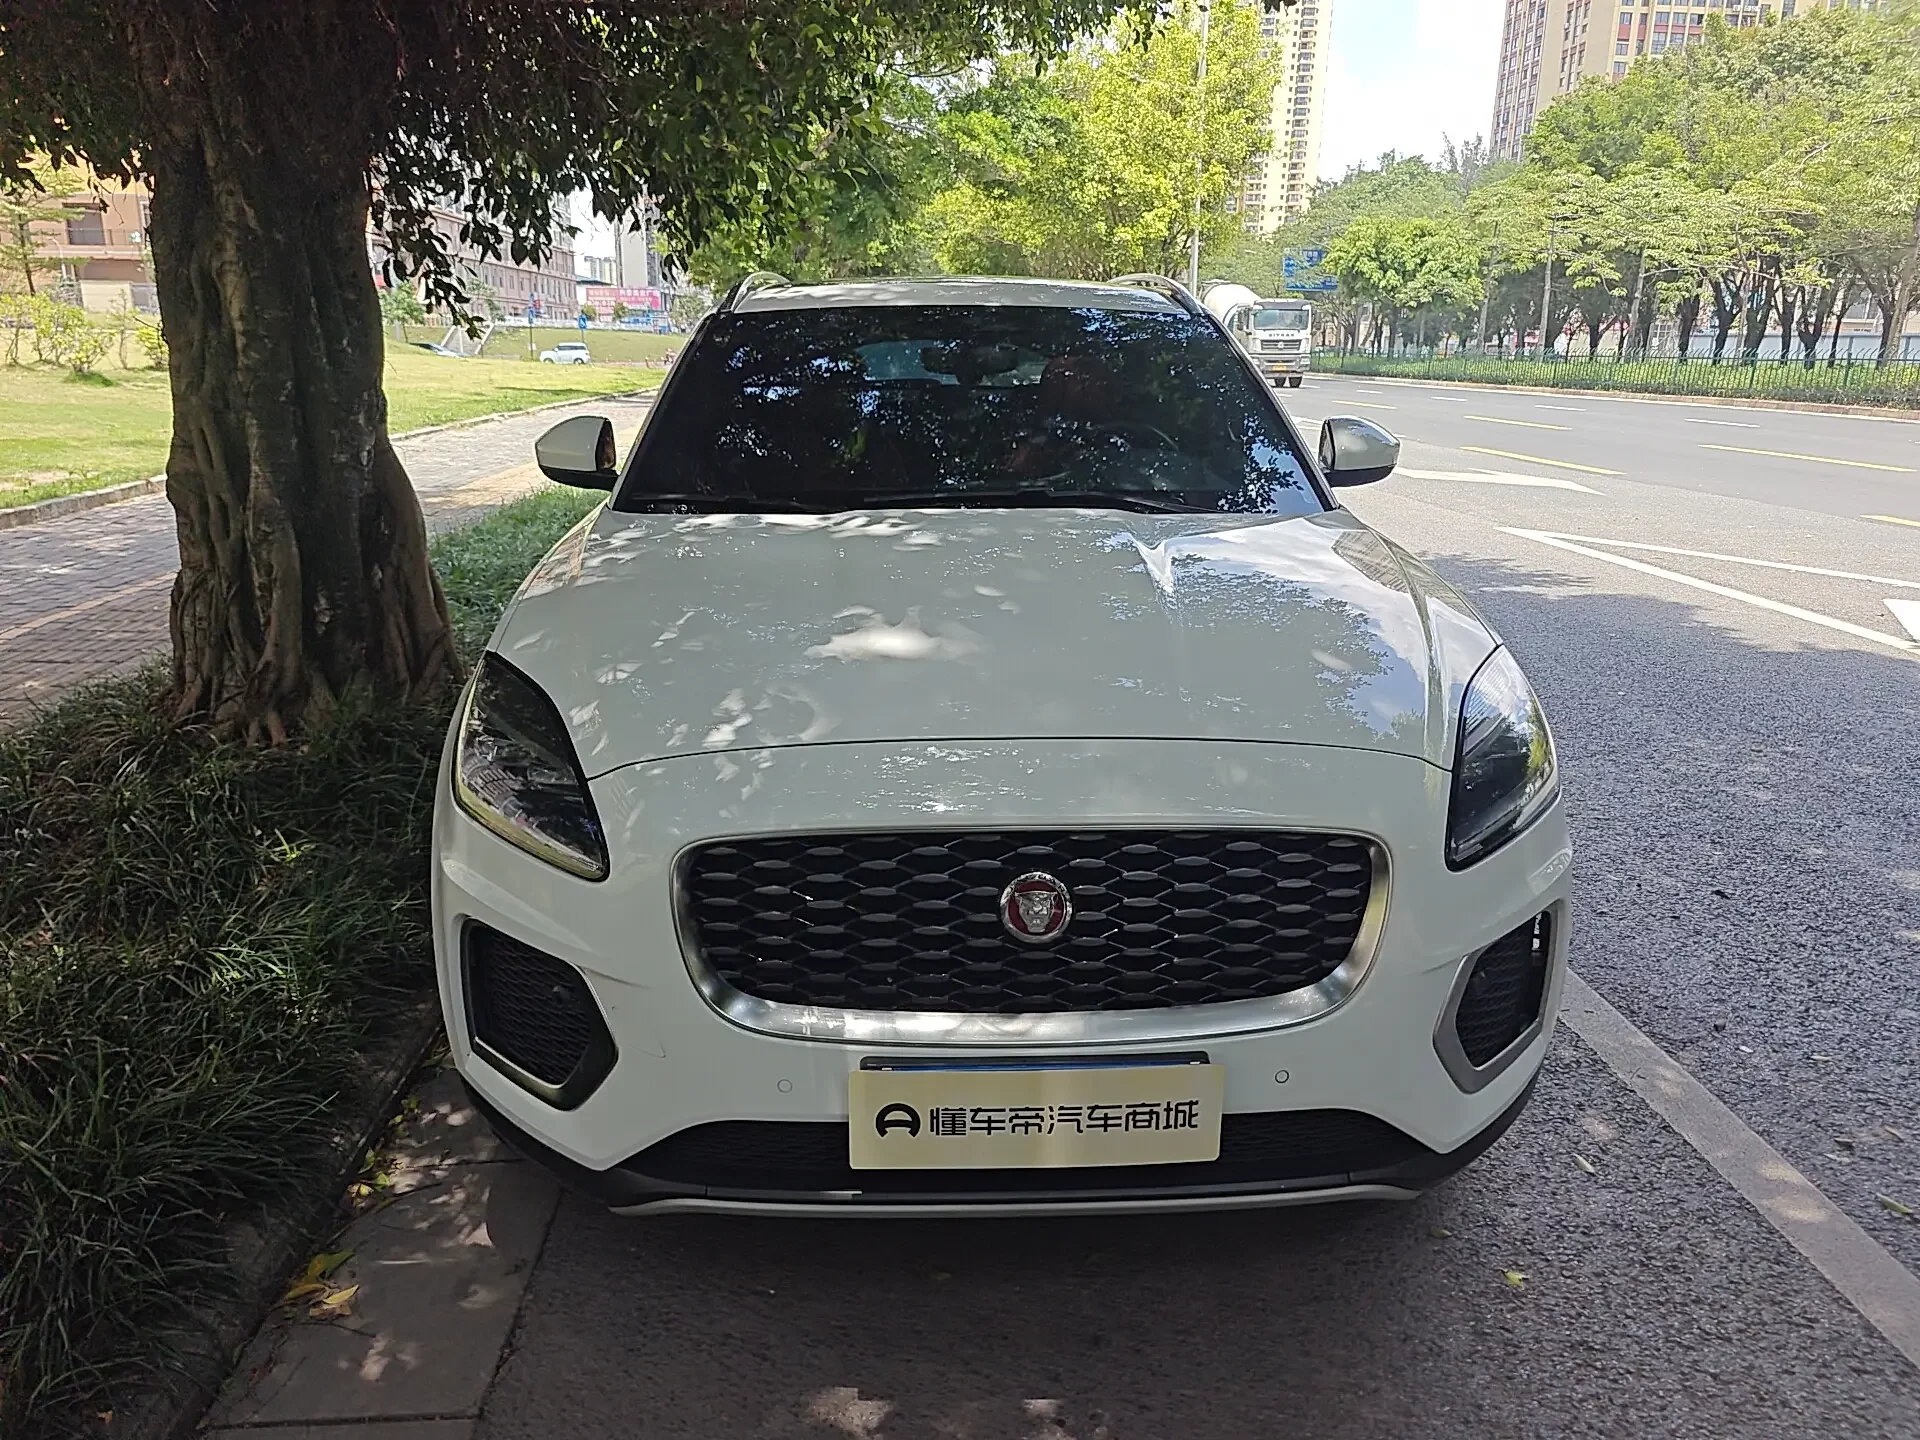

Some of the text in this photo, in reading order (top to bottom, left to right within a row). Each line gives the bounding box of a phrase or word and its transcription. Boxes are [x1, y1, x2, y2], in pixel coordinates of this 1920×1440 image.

[929, 1099, 1200, 1137] 懂车帝汽车商城
